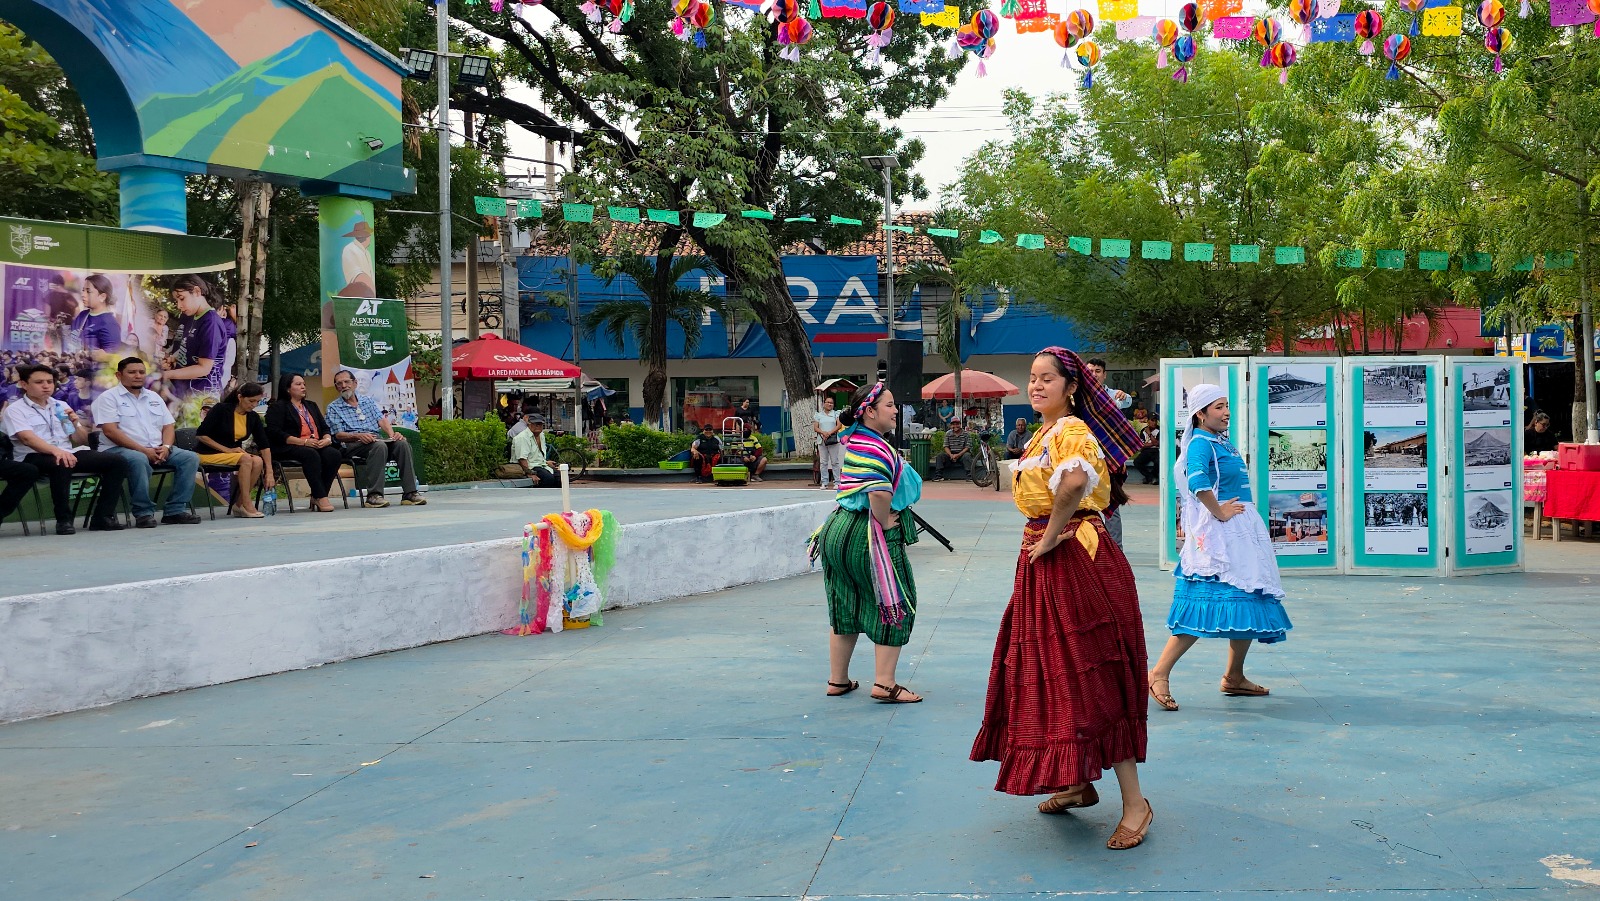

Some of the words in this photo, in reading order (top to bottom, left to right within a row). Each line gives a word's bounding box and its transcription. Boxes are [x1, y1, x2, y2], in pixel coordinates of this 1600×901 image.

[15, 277, 31, 285] AT
[355, 299, 384, 316] AT
[493, 353, 532, 362] Claro
